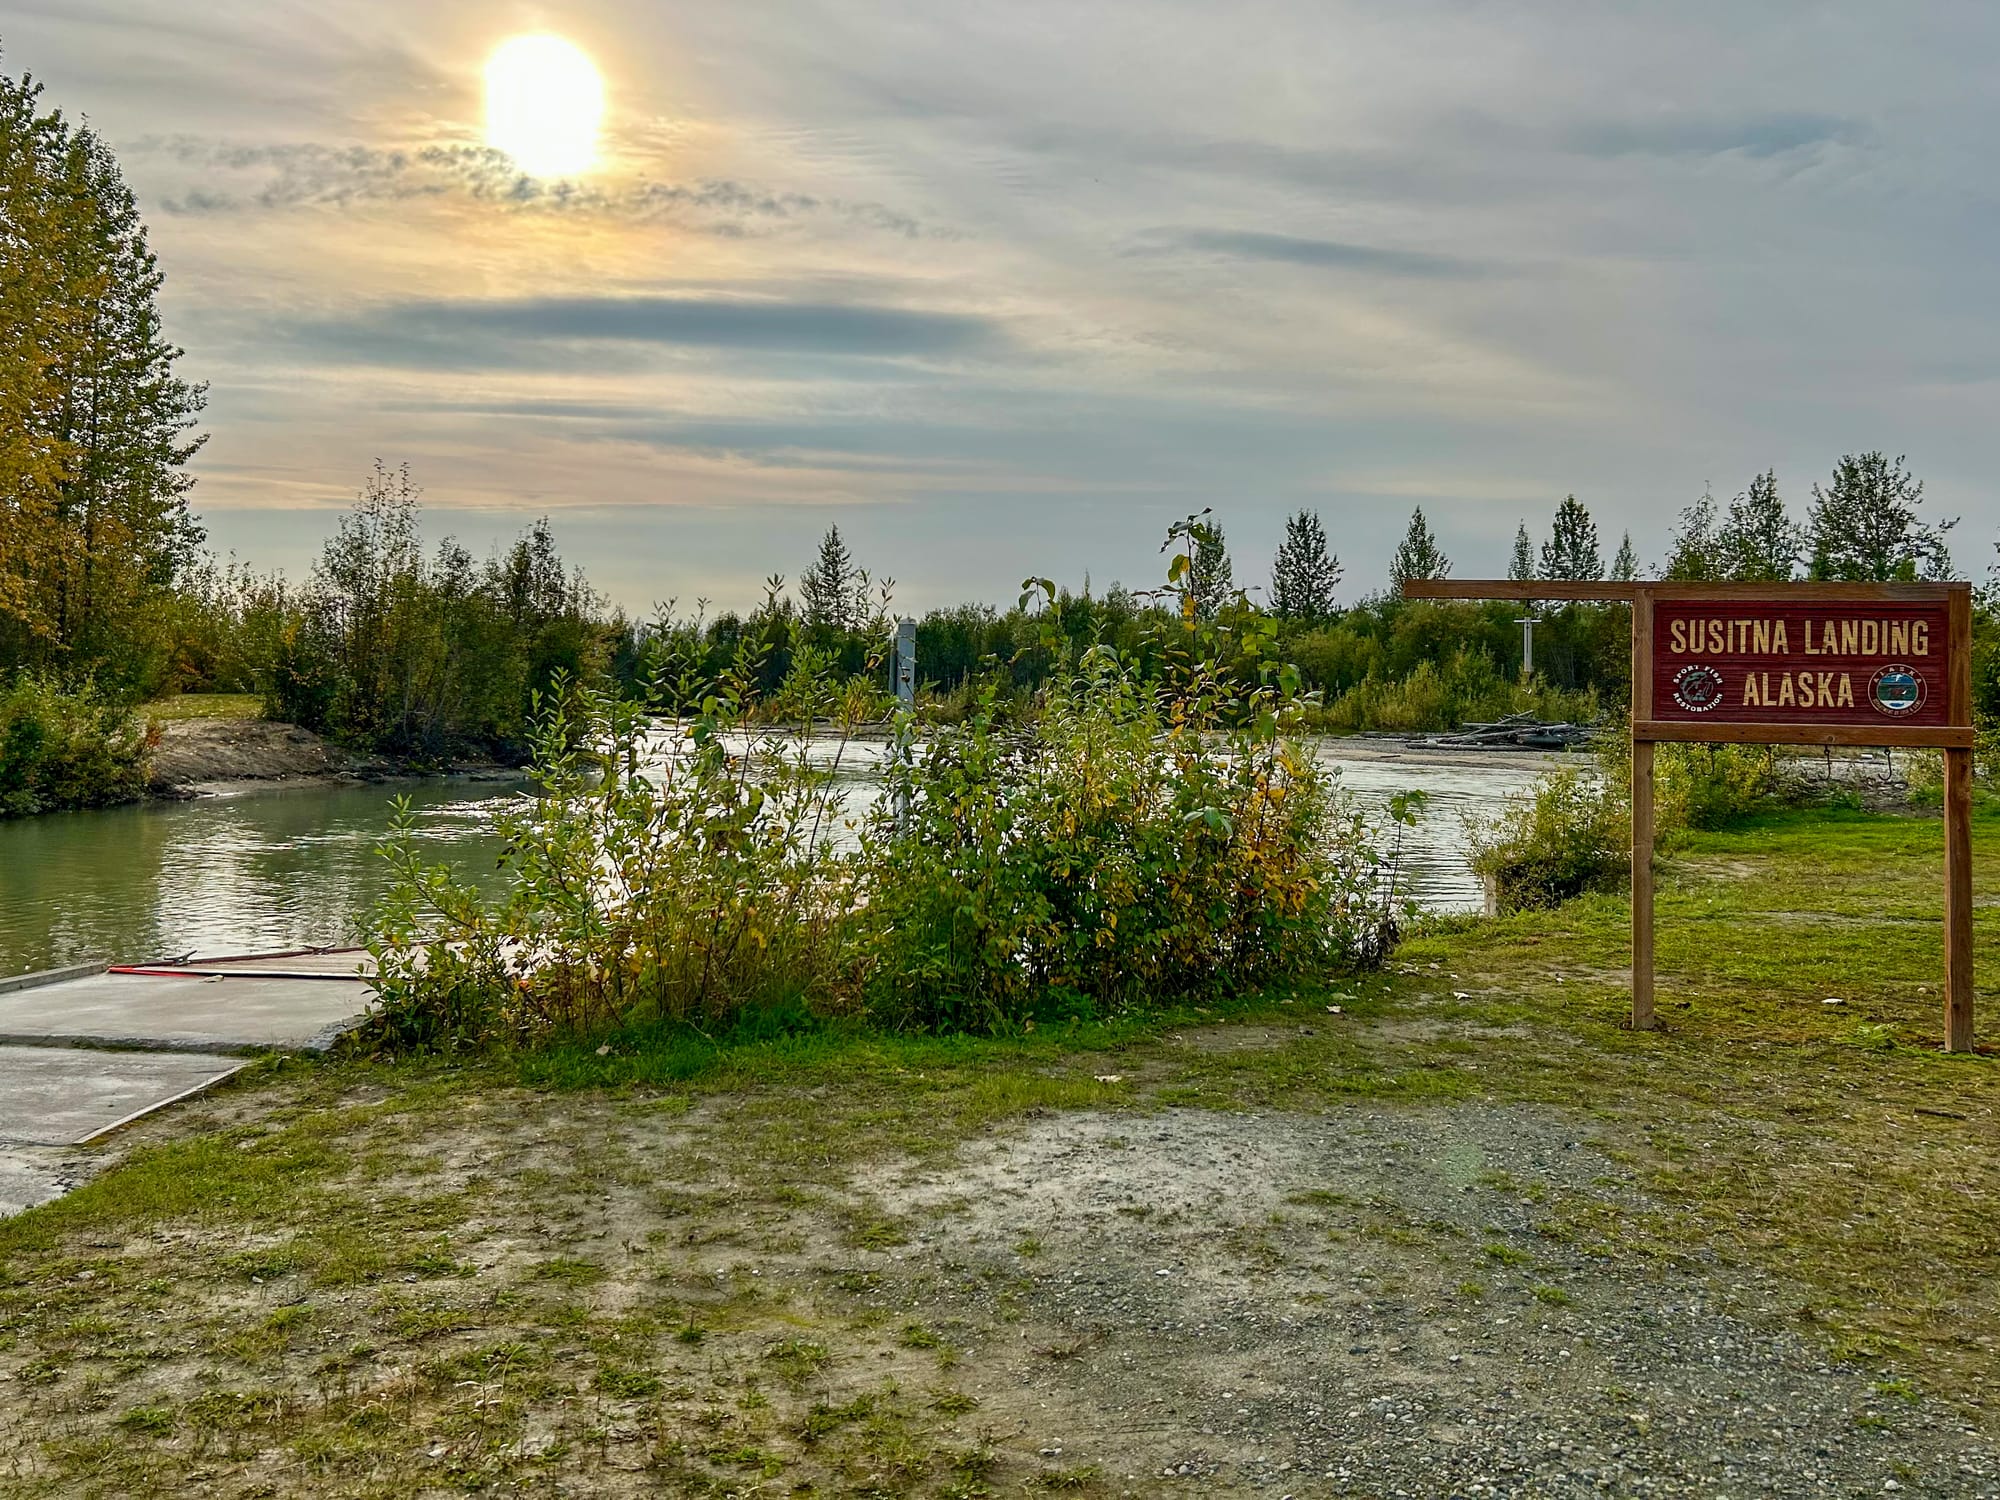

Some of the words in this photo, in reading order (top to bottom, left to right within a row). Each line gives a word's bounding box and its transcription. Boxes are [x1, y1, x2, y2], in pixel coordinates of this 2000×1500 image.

[1670, 619, 1789, 655] SUSITNA
[1805, 619, 1929, 656] LANDING
[1673, 665, 1699, 684] SPORT
[1704, 665, 1723, 684] FISH
[1673, 692, 1723, 712] RESTORATION
[1743, 671, 1854, 708] ALASKA
